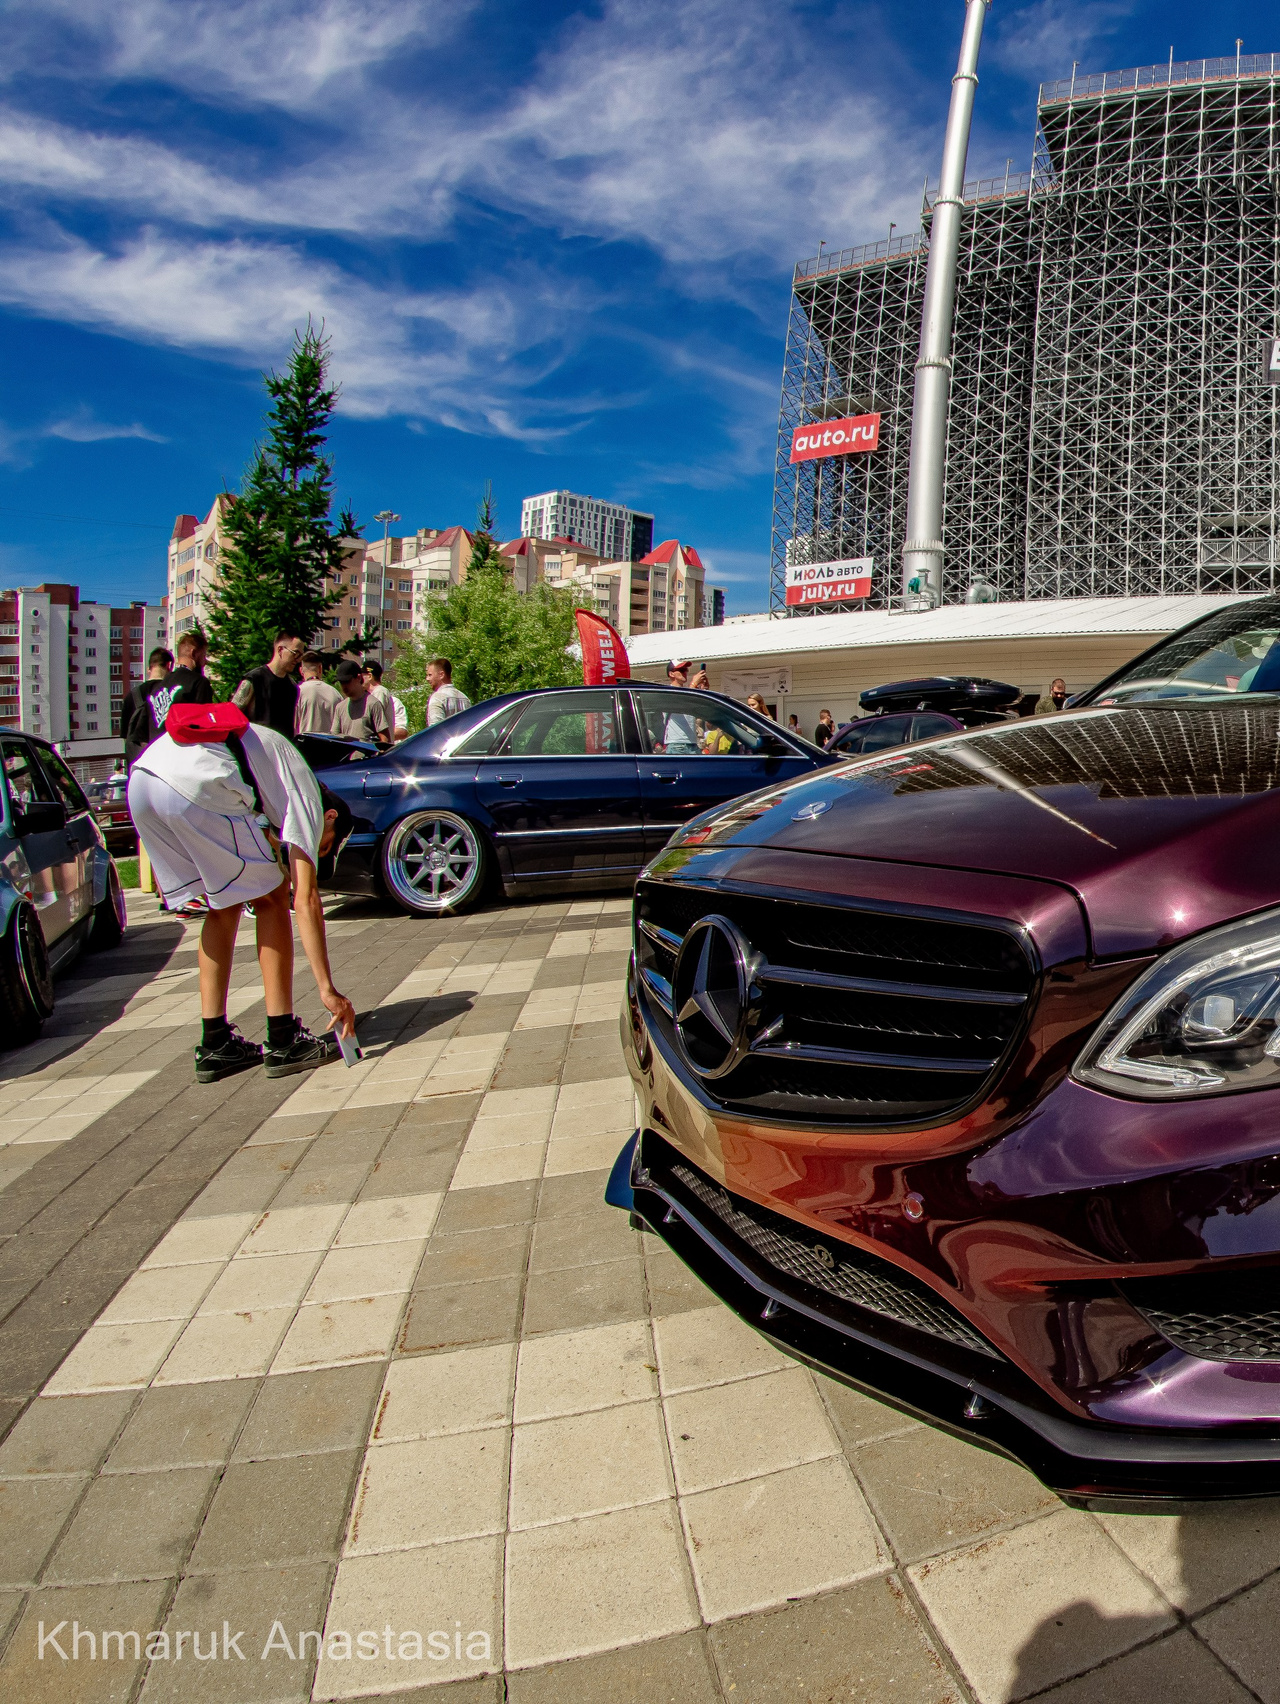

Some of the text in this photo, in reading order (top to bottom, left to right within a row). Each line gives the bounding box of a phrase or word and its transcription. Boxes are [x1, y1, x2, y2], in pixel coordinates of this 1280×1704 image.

[795, 424, 875, 451] auto.ru
[836, 565, 863, 577] авто
[800, 582, 855, 602] july.ru
